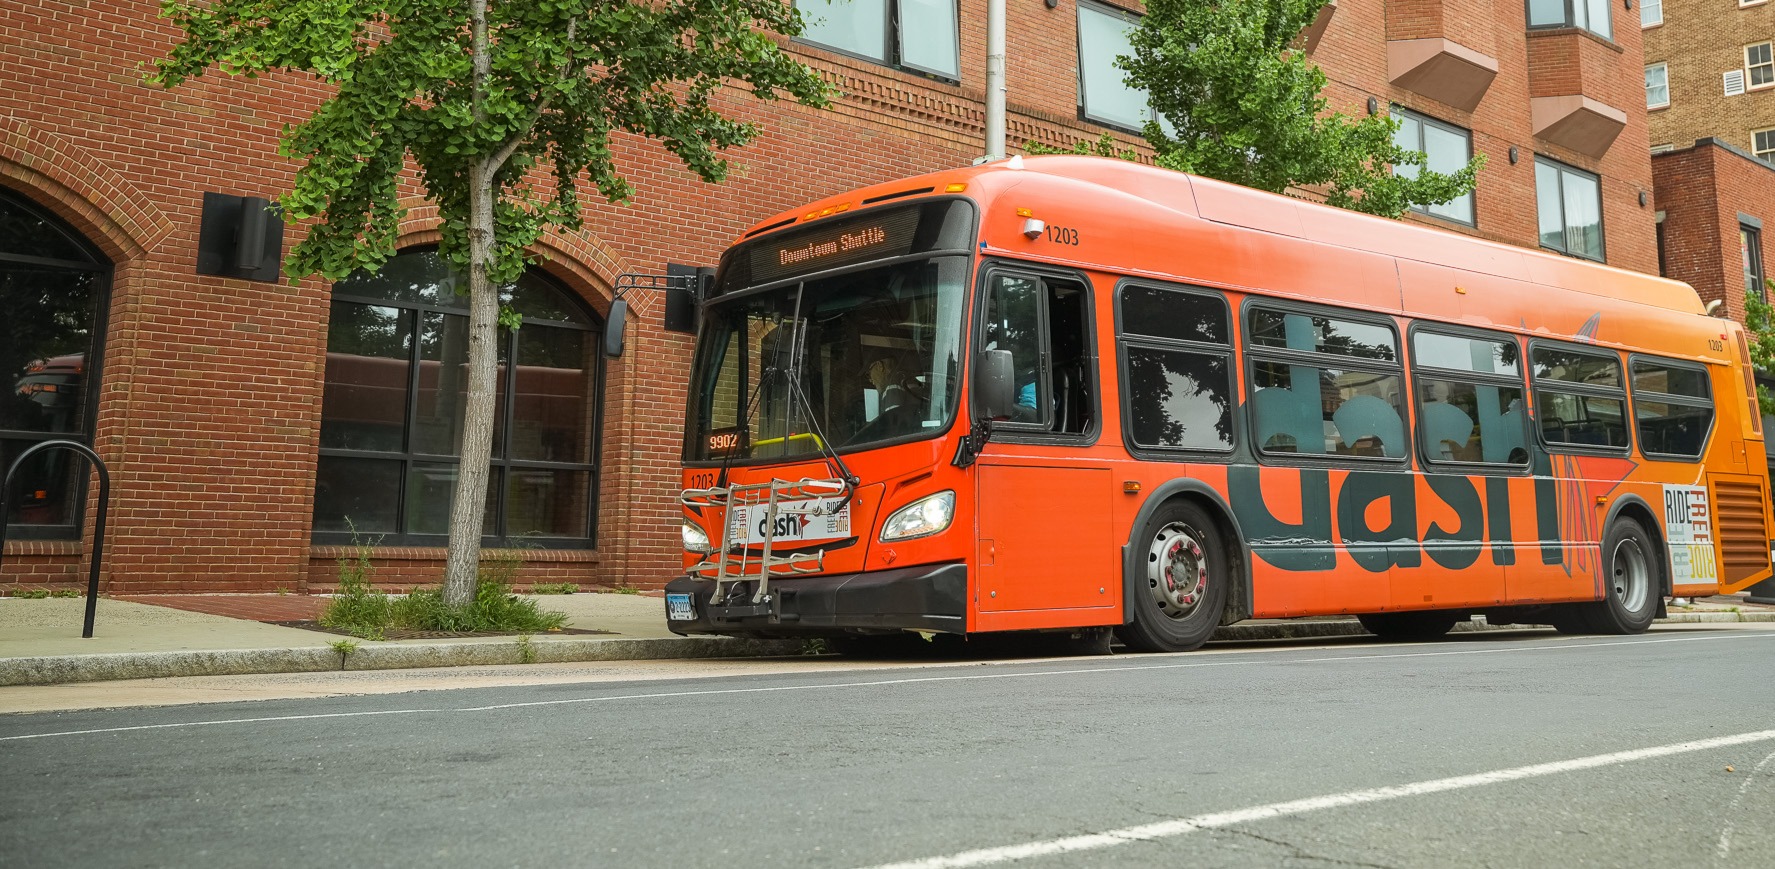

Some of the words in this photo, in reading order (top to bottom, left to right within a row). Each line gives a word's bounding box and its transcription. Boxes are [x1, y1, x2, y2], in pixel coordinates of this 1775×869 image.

[780, 242, 837, 265] Downtown
[840, 227, 885, 251] Shuttle
[1045, 224, 1079, 246] 1203
[1707, 339, 1723, 352] 1203
[709, 433, 738, 450] 9902
[691, 473, 714, 489] 1203
[1665, 489, 1692, 525] RIDE
[1689, 490, 1709, 543] FREE
[758, 511, 798, 538] dash
